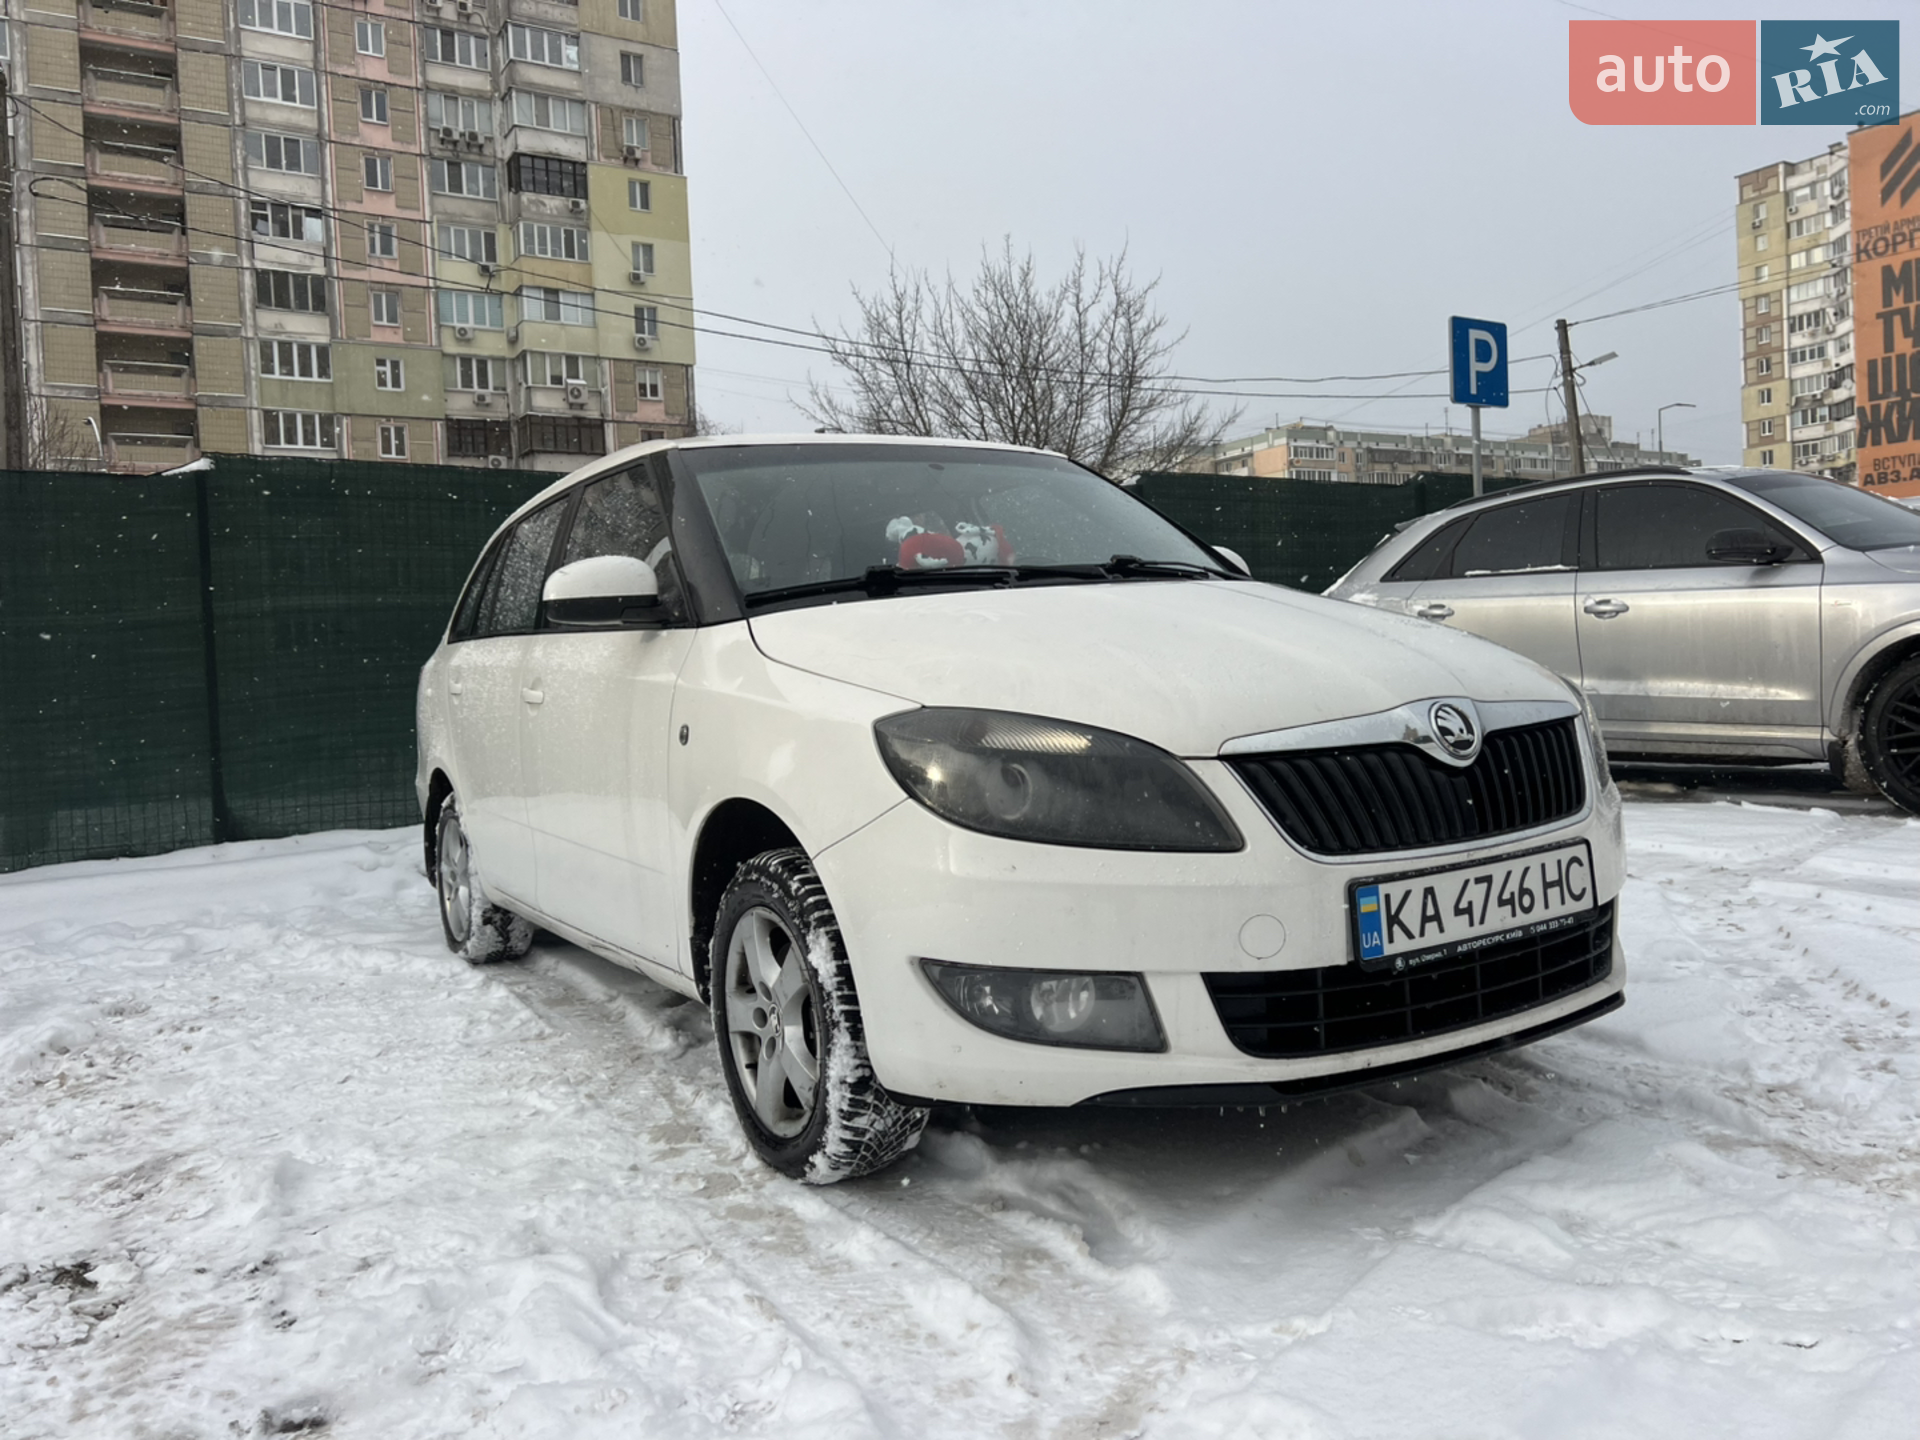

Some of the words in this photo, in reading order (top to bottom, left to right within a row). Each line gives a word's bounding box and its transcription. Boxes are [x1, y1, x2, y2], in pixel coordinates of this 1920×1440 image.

[1881, 257, 1920, 309] М
[1468, 328, 1498, 395] P
[1384, 886, 1446, 944] KA
[1453, 866, 1535, 928] 4746
[1541, 855, 1588, 911] HC
[1362, 931, 1382, 950] UA
